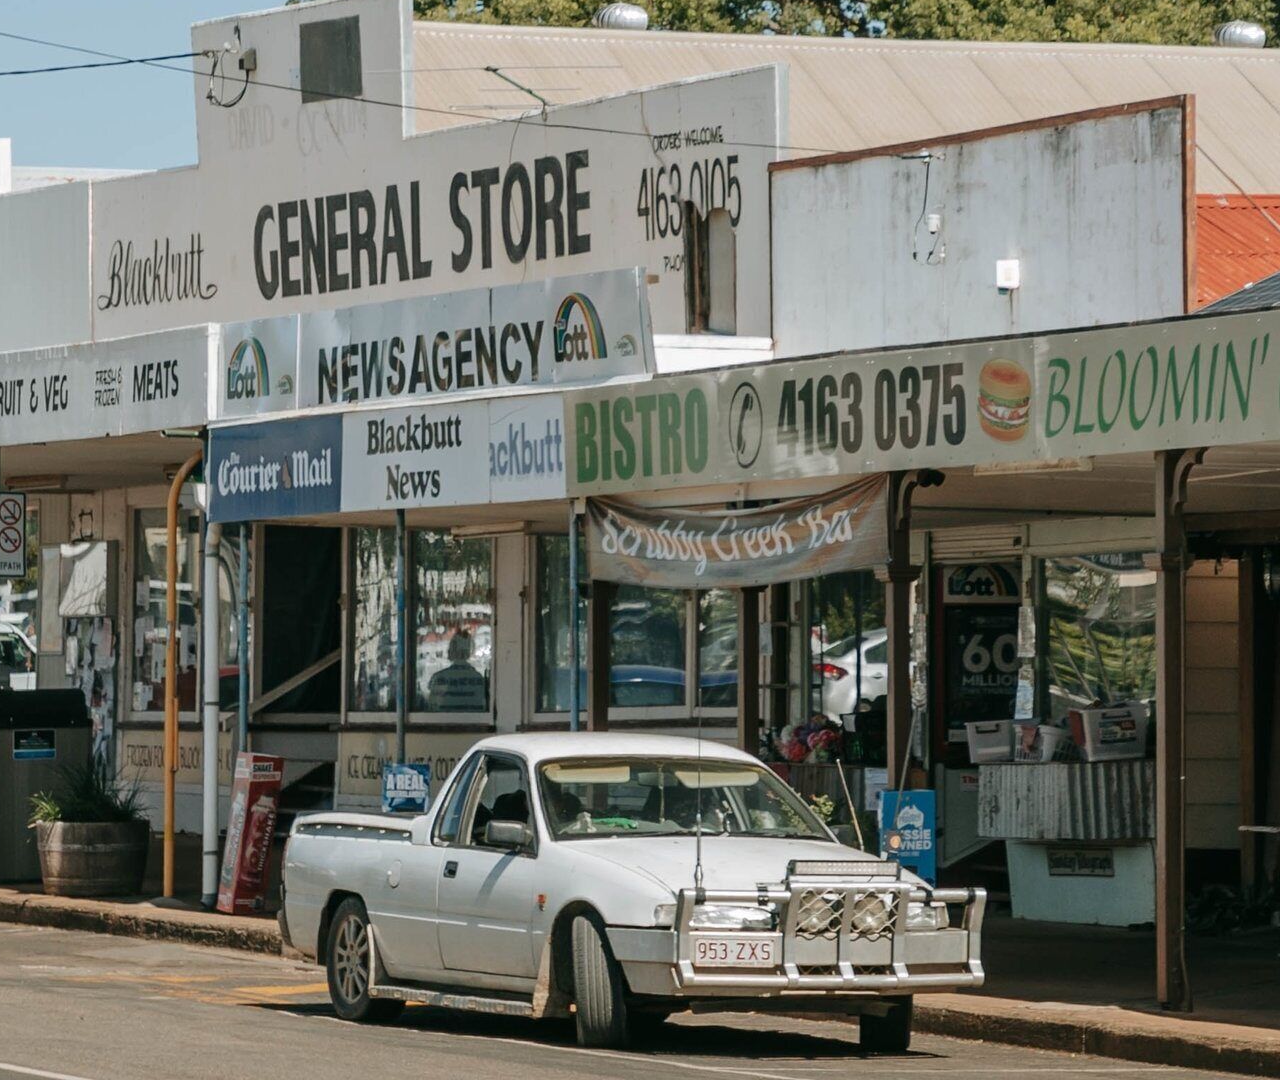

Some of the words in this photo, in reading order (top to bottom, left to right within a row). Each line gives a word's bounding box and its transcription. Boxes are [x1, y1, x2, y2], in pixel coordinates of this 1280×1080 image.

[685, 125, 724, 147] WELCOME
[254, 180, 432, 300] GENERAL
[449, 149, 591, 273] STORE
[637, 163, 682, 241] 4163
[97, 232, 218, 311] Blackbutt
[133, 360, 179, 402] MEATS
[318, 320, 544, 404] NEWSAGENCY
[1044, 333, 1269, 437] BLOOMIN'
[30, 379, 38, 413] &
[44, 375, 68, 412] VEG
[367, 413, 462, 455] Blackbutt
[574, 387, 709, 484] BISTRO
[777, 371, 863, 458] 4163
[874, 362, 966, 451] 0375
[218, 456, 281, 496] Courier
[292, 447, 332, 488] Mail
[386, 464, 441, 500] News
[602, 509, 707, 576] Scrubby
[711, 514, 795, 561] Creek
[798, 504, 858, 549] Bar
[962, 674, 1018, 687] MILLIO
[387, 775, 395, 789] A
[397, 775, 424, 790] REAL
